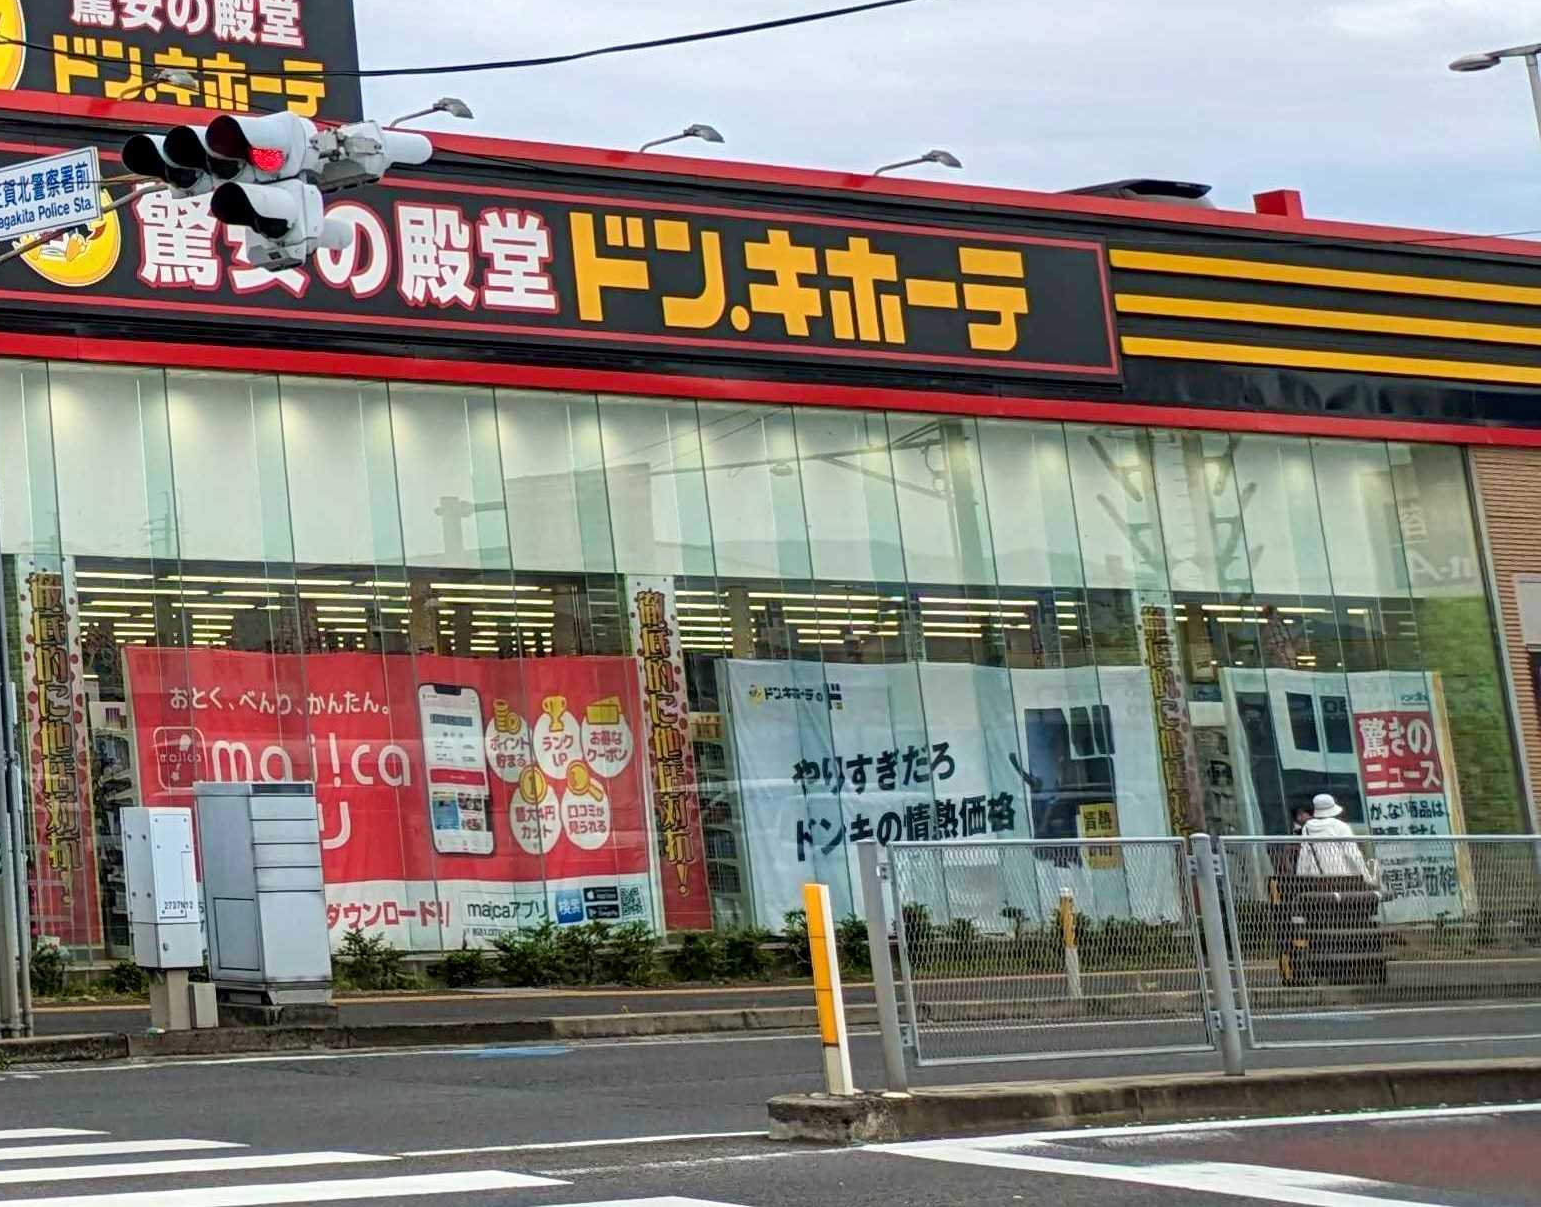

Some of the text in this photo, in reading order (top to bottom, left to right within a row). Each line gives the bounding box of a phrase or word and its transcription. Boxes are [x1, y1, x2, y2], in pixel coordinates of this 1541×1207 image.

[38, 203, 70, 221] Police
[73, 196, 94, 214] Sta.
[542, 735, 574, 751] ランク
[1357, 716, 1433, 759] 驚きの
[792, 742, 955, 795] やりすぎだろ
[1365, 760, 1442, 790] ニュース
[796, 792, 1015, 862] ドンキの情熱価格
